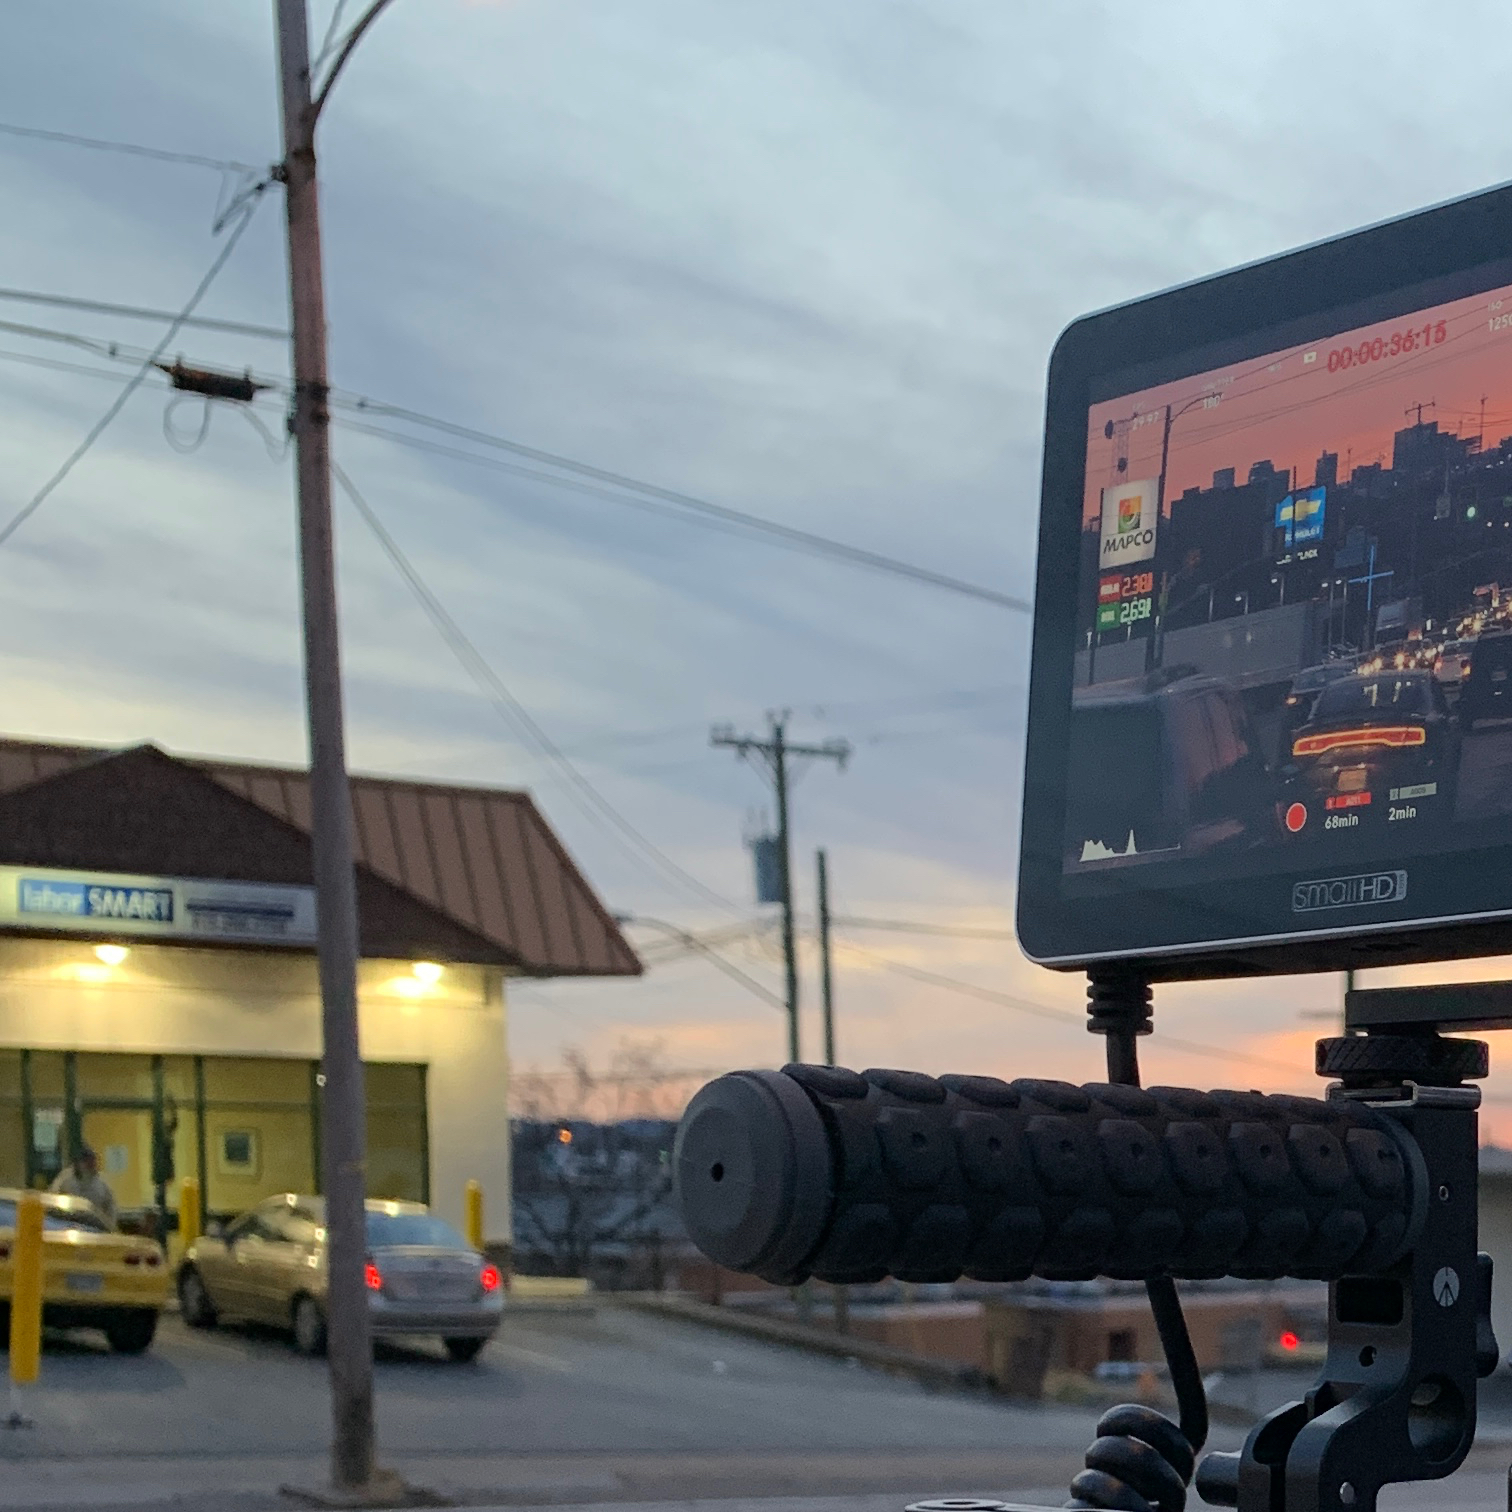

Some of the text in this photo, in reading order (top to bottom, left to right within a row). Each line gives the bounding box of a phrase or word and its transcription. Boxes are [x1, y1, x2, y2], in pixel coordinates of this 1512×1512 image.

[1103, 529, 1154, 554] MAPCO
[1324, 814, 1359, 829] 68min
[1388, 805, 1417, 821] 2min
[23, 883, 83, 914] labor
[88, 887, 171, 919] SMART
[1294, 875, 1394, 909] smallHD
